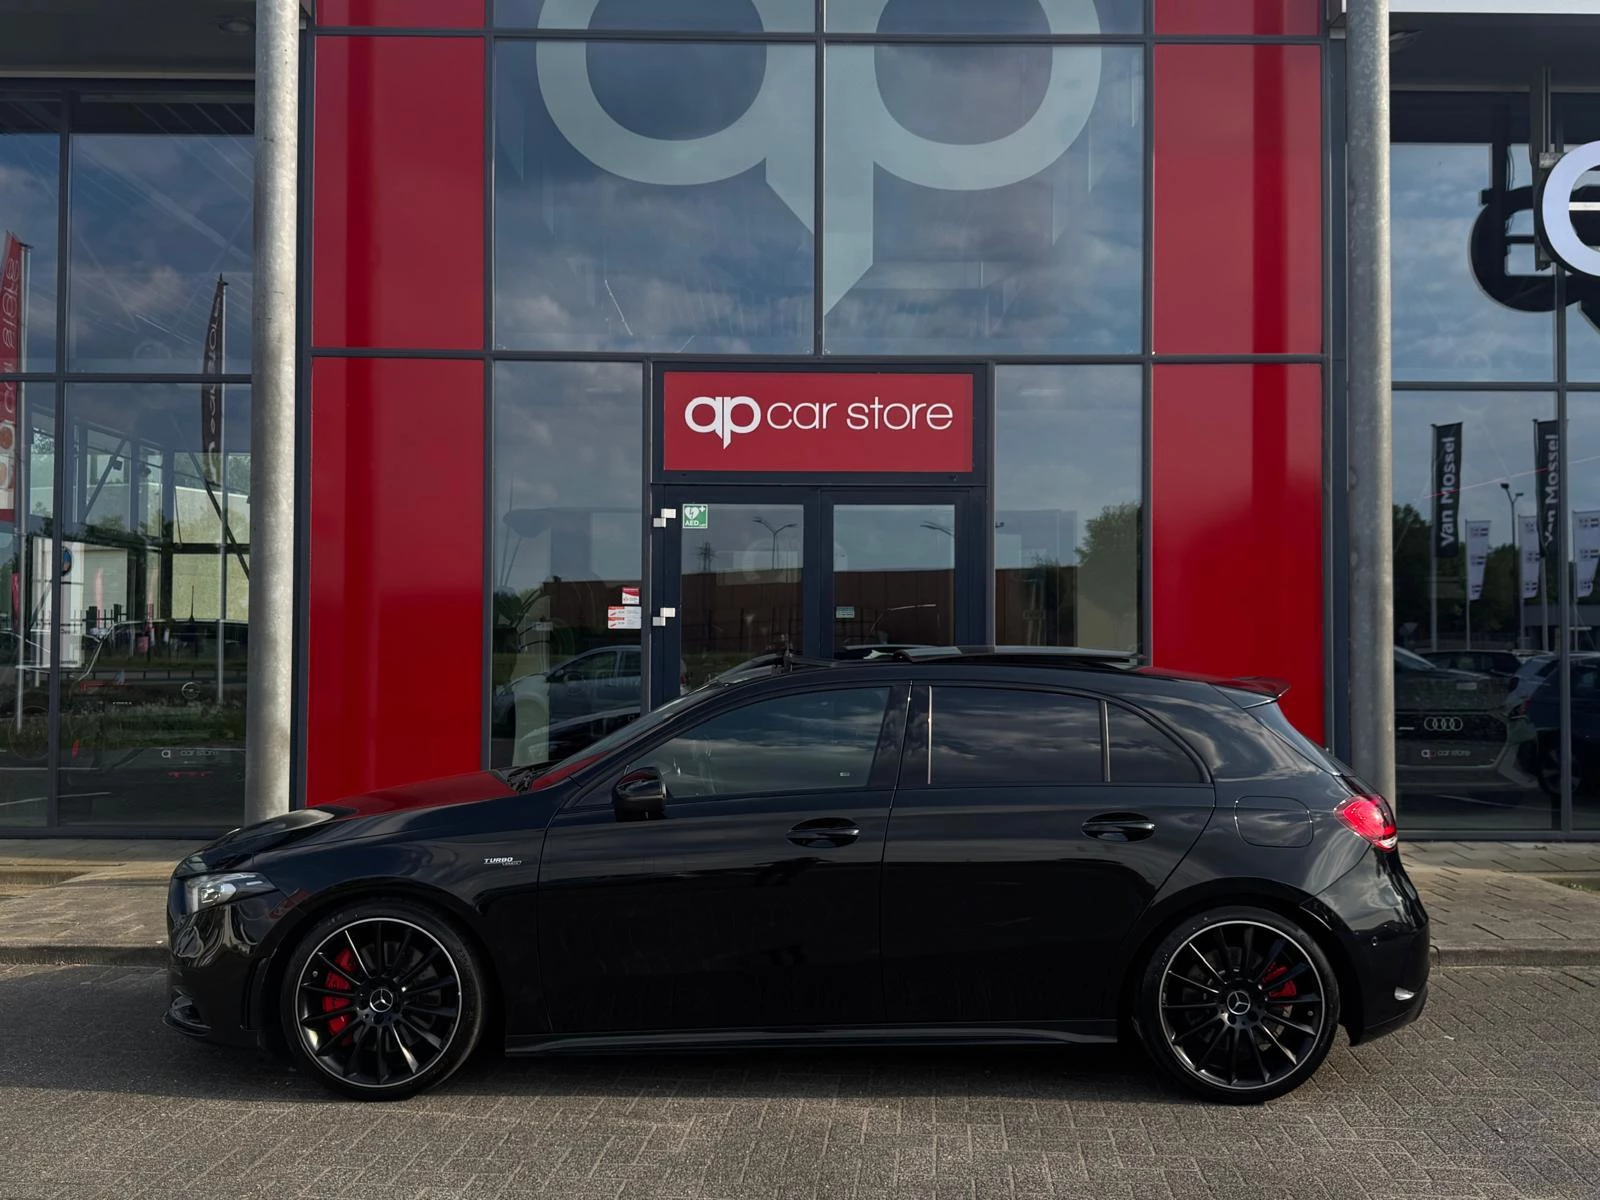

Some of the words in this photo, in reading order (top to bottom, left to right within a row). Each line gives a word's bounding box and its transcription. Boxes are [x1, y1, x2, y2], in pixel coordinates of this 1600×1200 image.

[684, 396, 762, 450] ap
[766, 402, 837, 430] car
[846, 396, 954, 430] store
[1440, 436, 1456, 504] Mossel
[1545, 434, 1559, 504] Mossel
[1440, 510, 1454, 547] Van
[484, 856, 514, 864] TURBO
